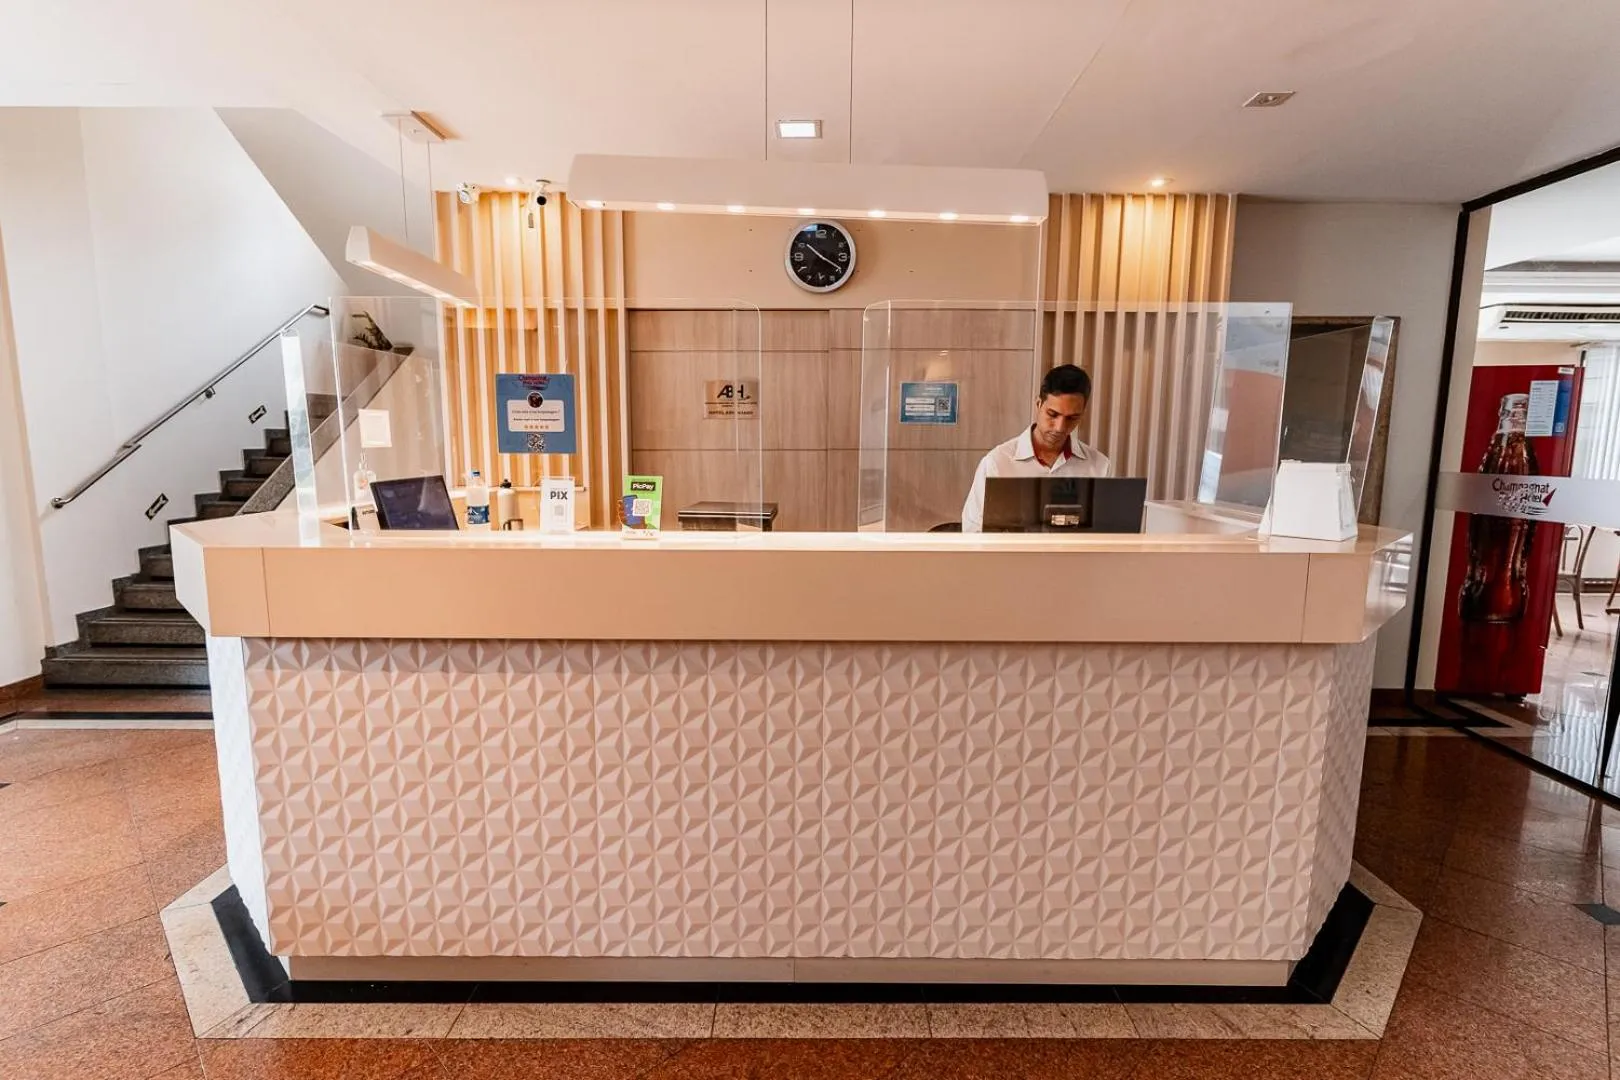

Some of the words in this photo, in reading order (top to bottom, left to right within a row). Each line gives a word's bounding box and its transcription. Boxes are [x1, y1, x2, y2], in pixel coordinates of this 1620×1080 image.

[794, 252, 804, 262] 9
[838, 252, 848, 262] 3
[632, 483, 654, 491] PicPay
[550, 490, 568, 500] PIX
